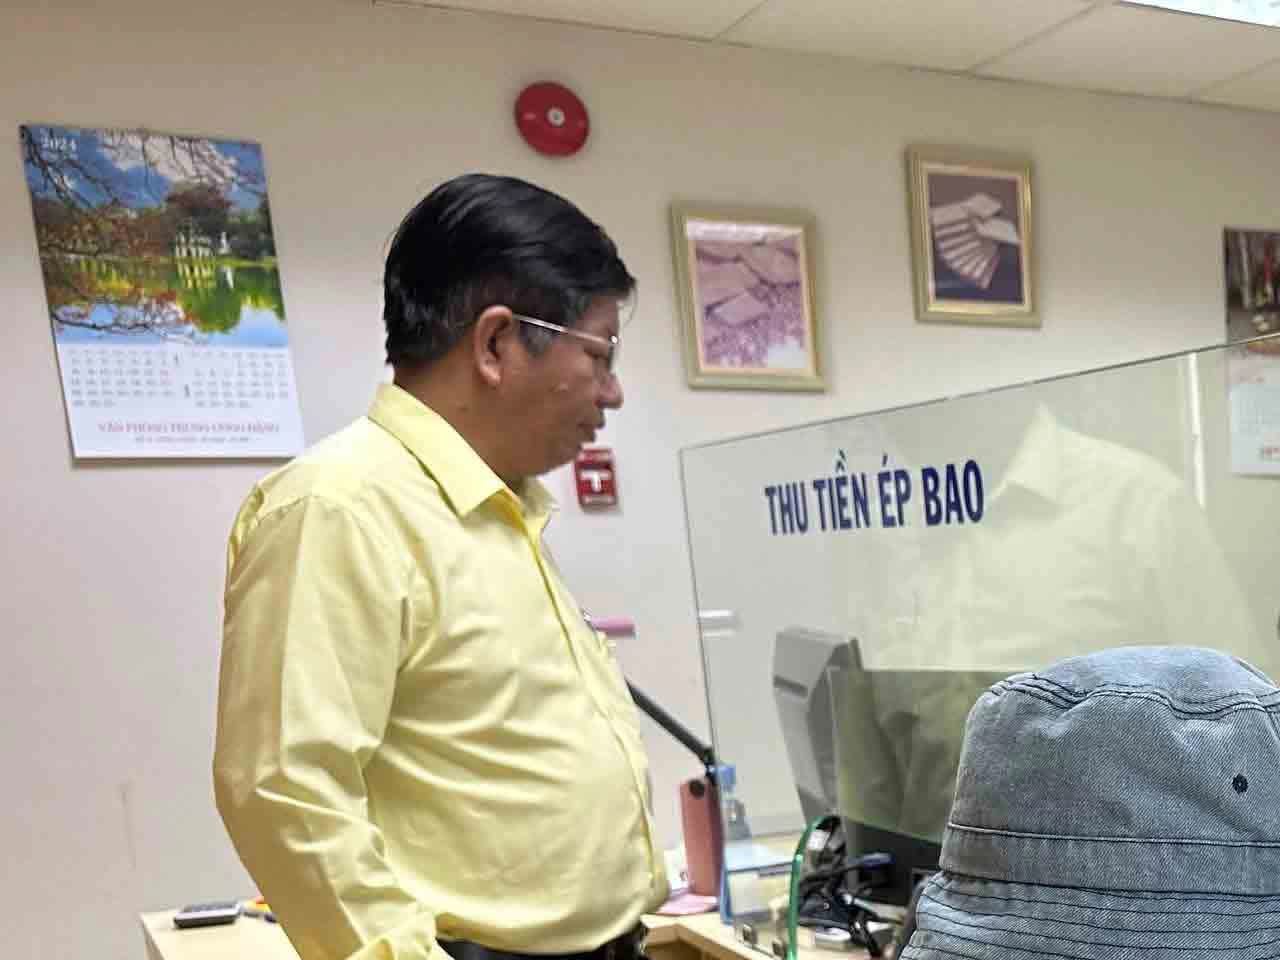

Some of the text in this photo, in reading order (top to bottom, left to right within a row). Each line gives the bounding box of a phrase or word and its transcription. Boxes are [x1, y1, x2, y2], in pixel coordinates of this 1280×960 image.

[764, 448, 984, 536] THU TIỀN ÉP BAO
